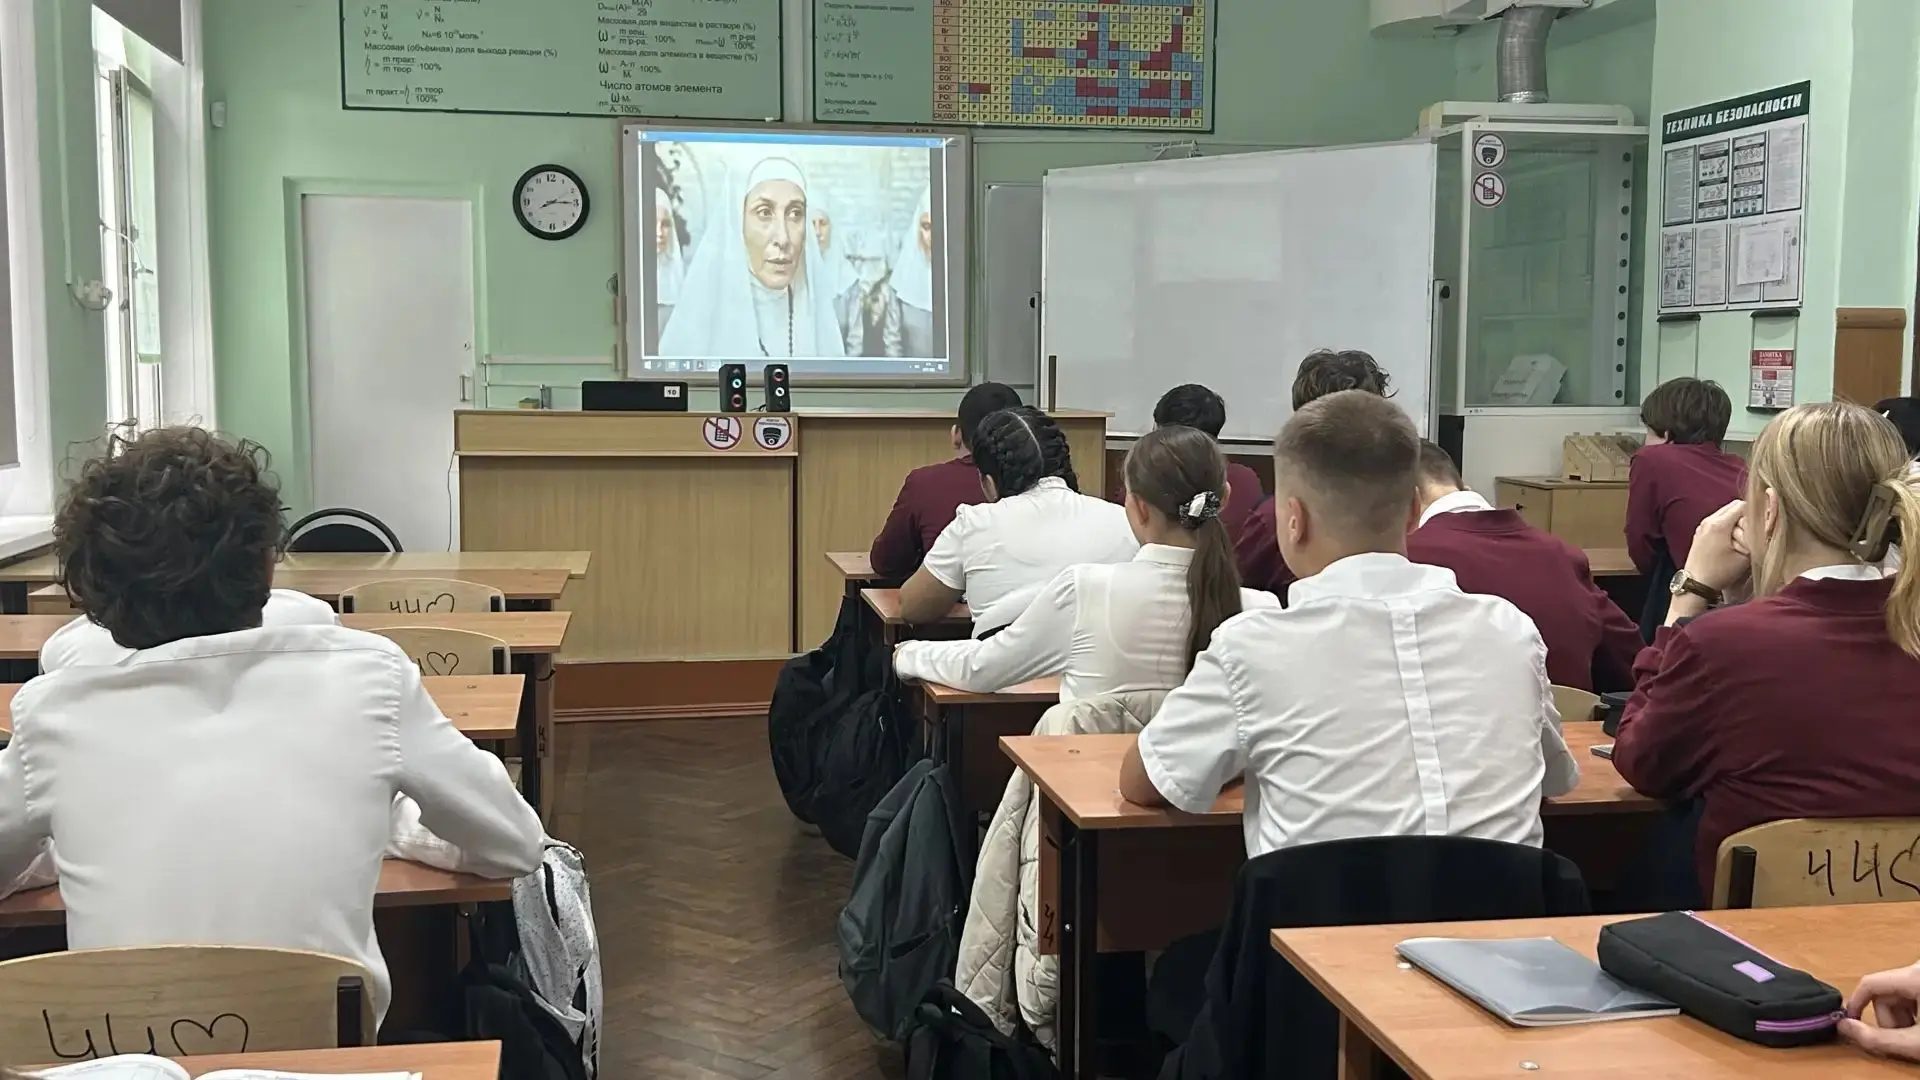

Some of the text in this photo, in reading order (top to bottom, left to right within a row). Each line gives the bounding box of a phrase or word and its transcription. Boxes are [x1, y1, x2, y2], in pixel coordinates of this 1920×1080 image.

[364, 42, 405, 51] Массовая
[420, 63, 442, 71] 100%
[600, 80, 723, 94] Число атомов элемента
[1666, 93, 1802, 134] ТЕХНИКА БЕЗОПАСНОСТИ
[546, 174, 557, 182] 12
